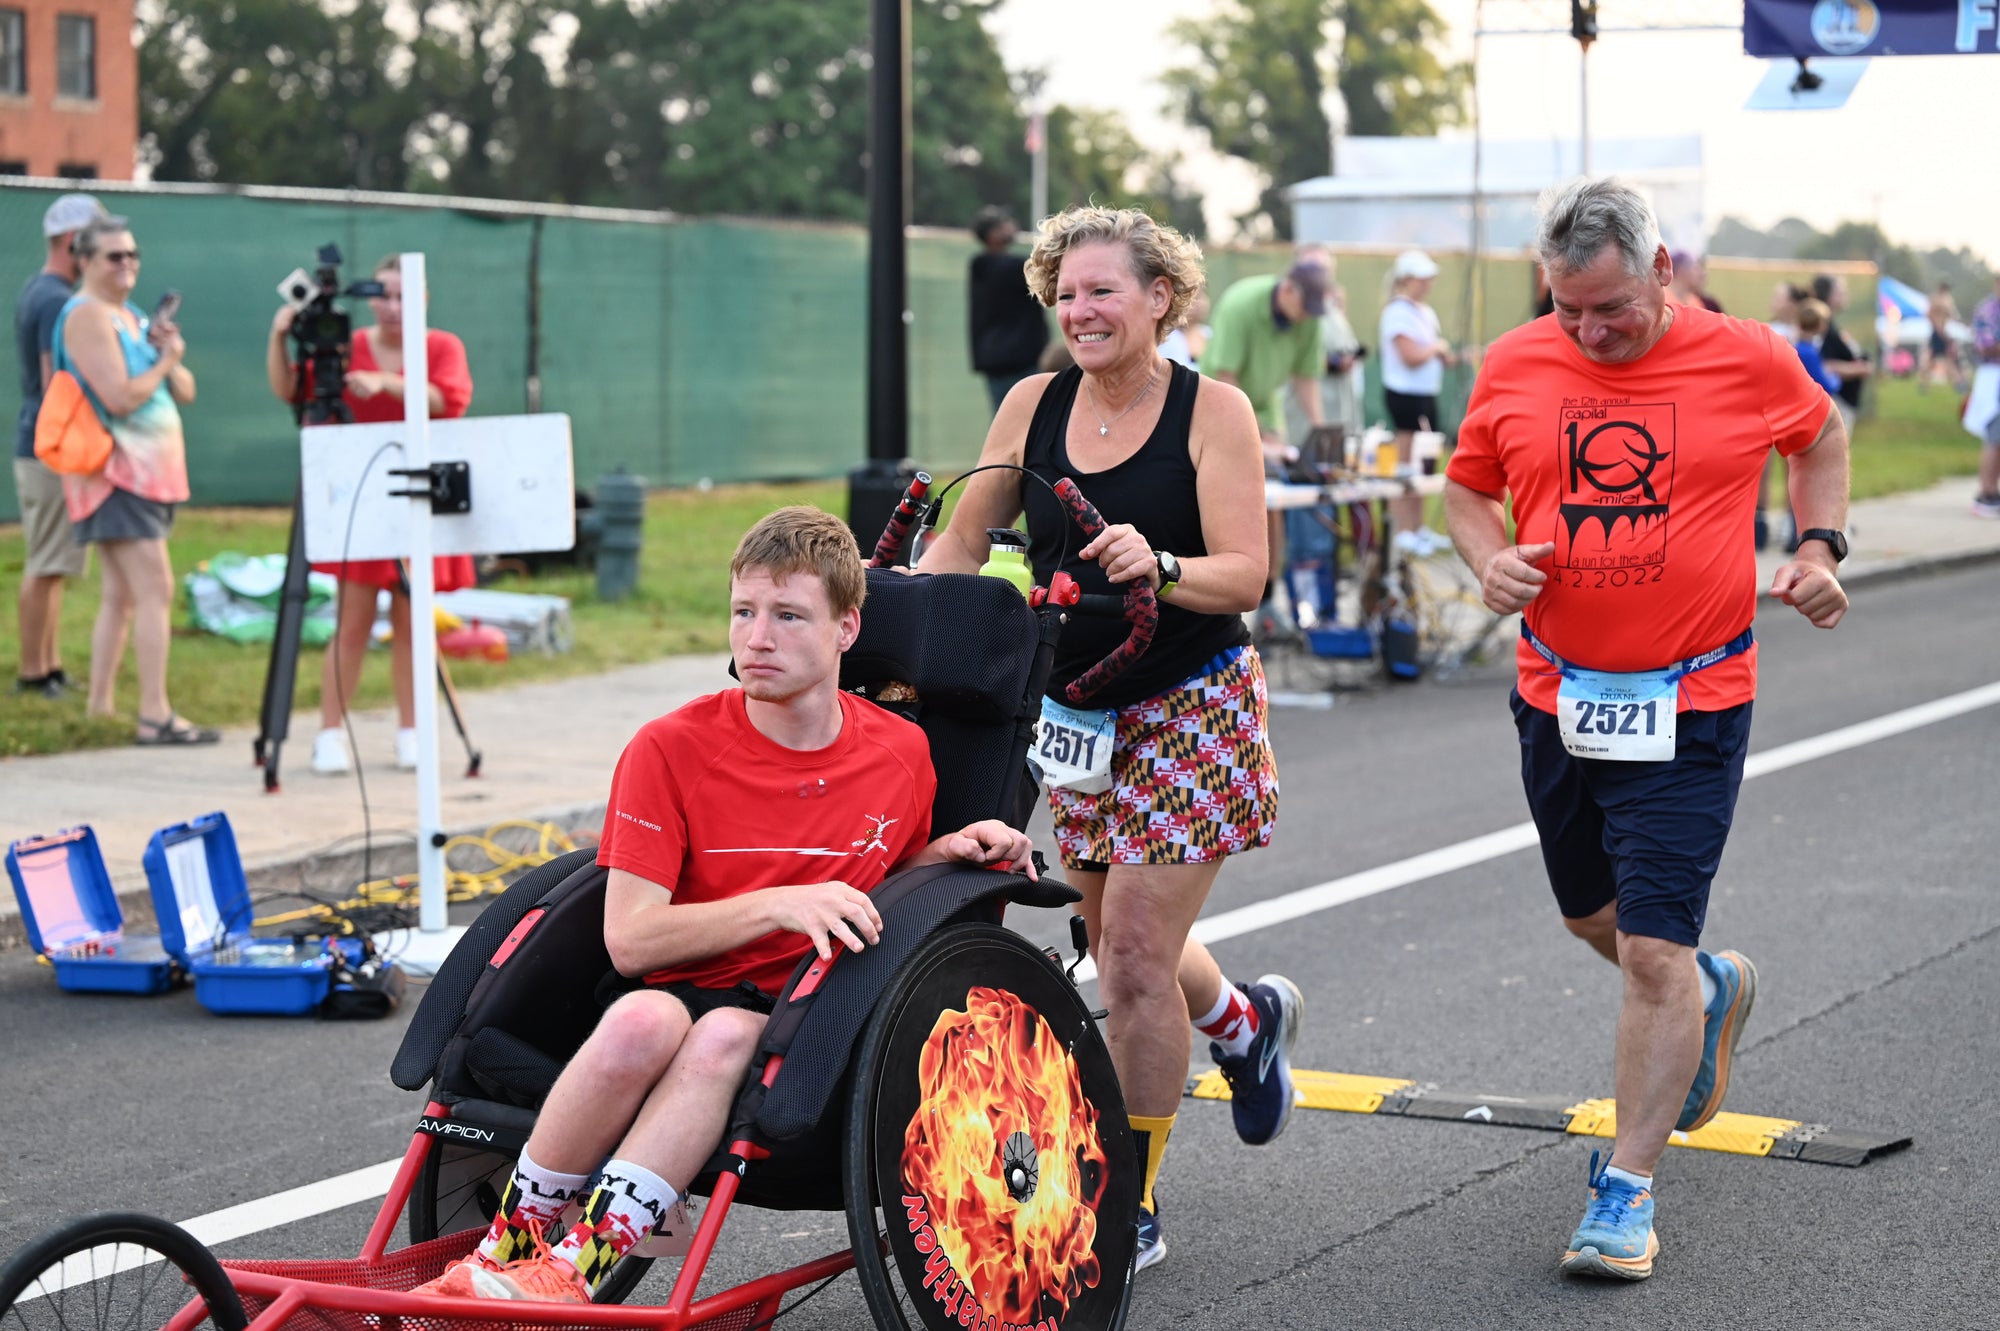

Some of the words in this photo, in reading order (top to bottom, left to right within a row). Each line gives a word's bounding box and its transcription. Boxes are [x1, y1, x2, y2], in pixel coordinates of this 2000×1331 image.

[1955, 0, 2000, 53] F
[1562, 397, 1578, 406] the
[1581, 396, 1598, 406] 12th
[1600, 395, 1630, 406] annual
[1565, 407, 1606, 421] capital
[1571, 557, 1579, 567] a
[1581, 556, 1597, 568] run
[1600, 555, 1616, 568] for
[1620, 553, 1639, 567] the
[1643, 549, 1663, 564] arts
[1554, 565, 1664, 588] 4.2.2022
[1600, 692, 1638, 701] DUANE
[1575, 700, 1657, 736] 2521
[1040, 721, 1097, 771] 2571
[639, 819, 662, 832] PURPOSE
[415, 1119, 495, 1142] AMPION
